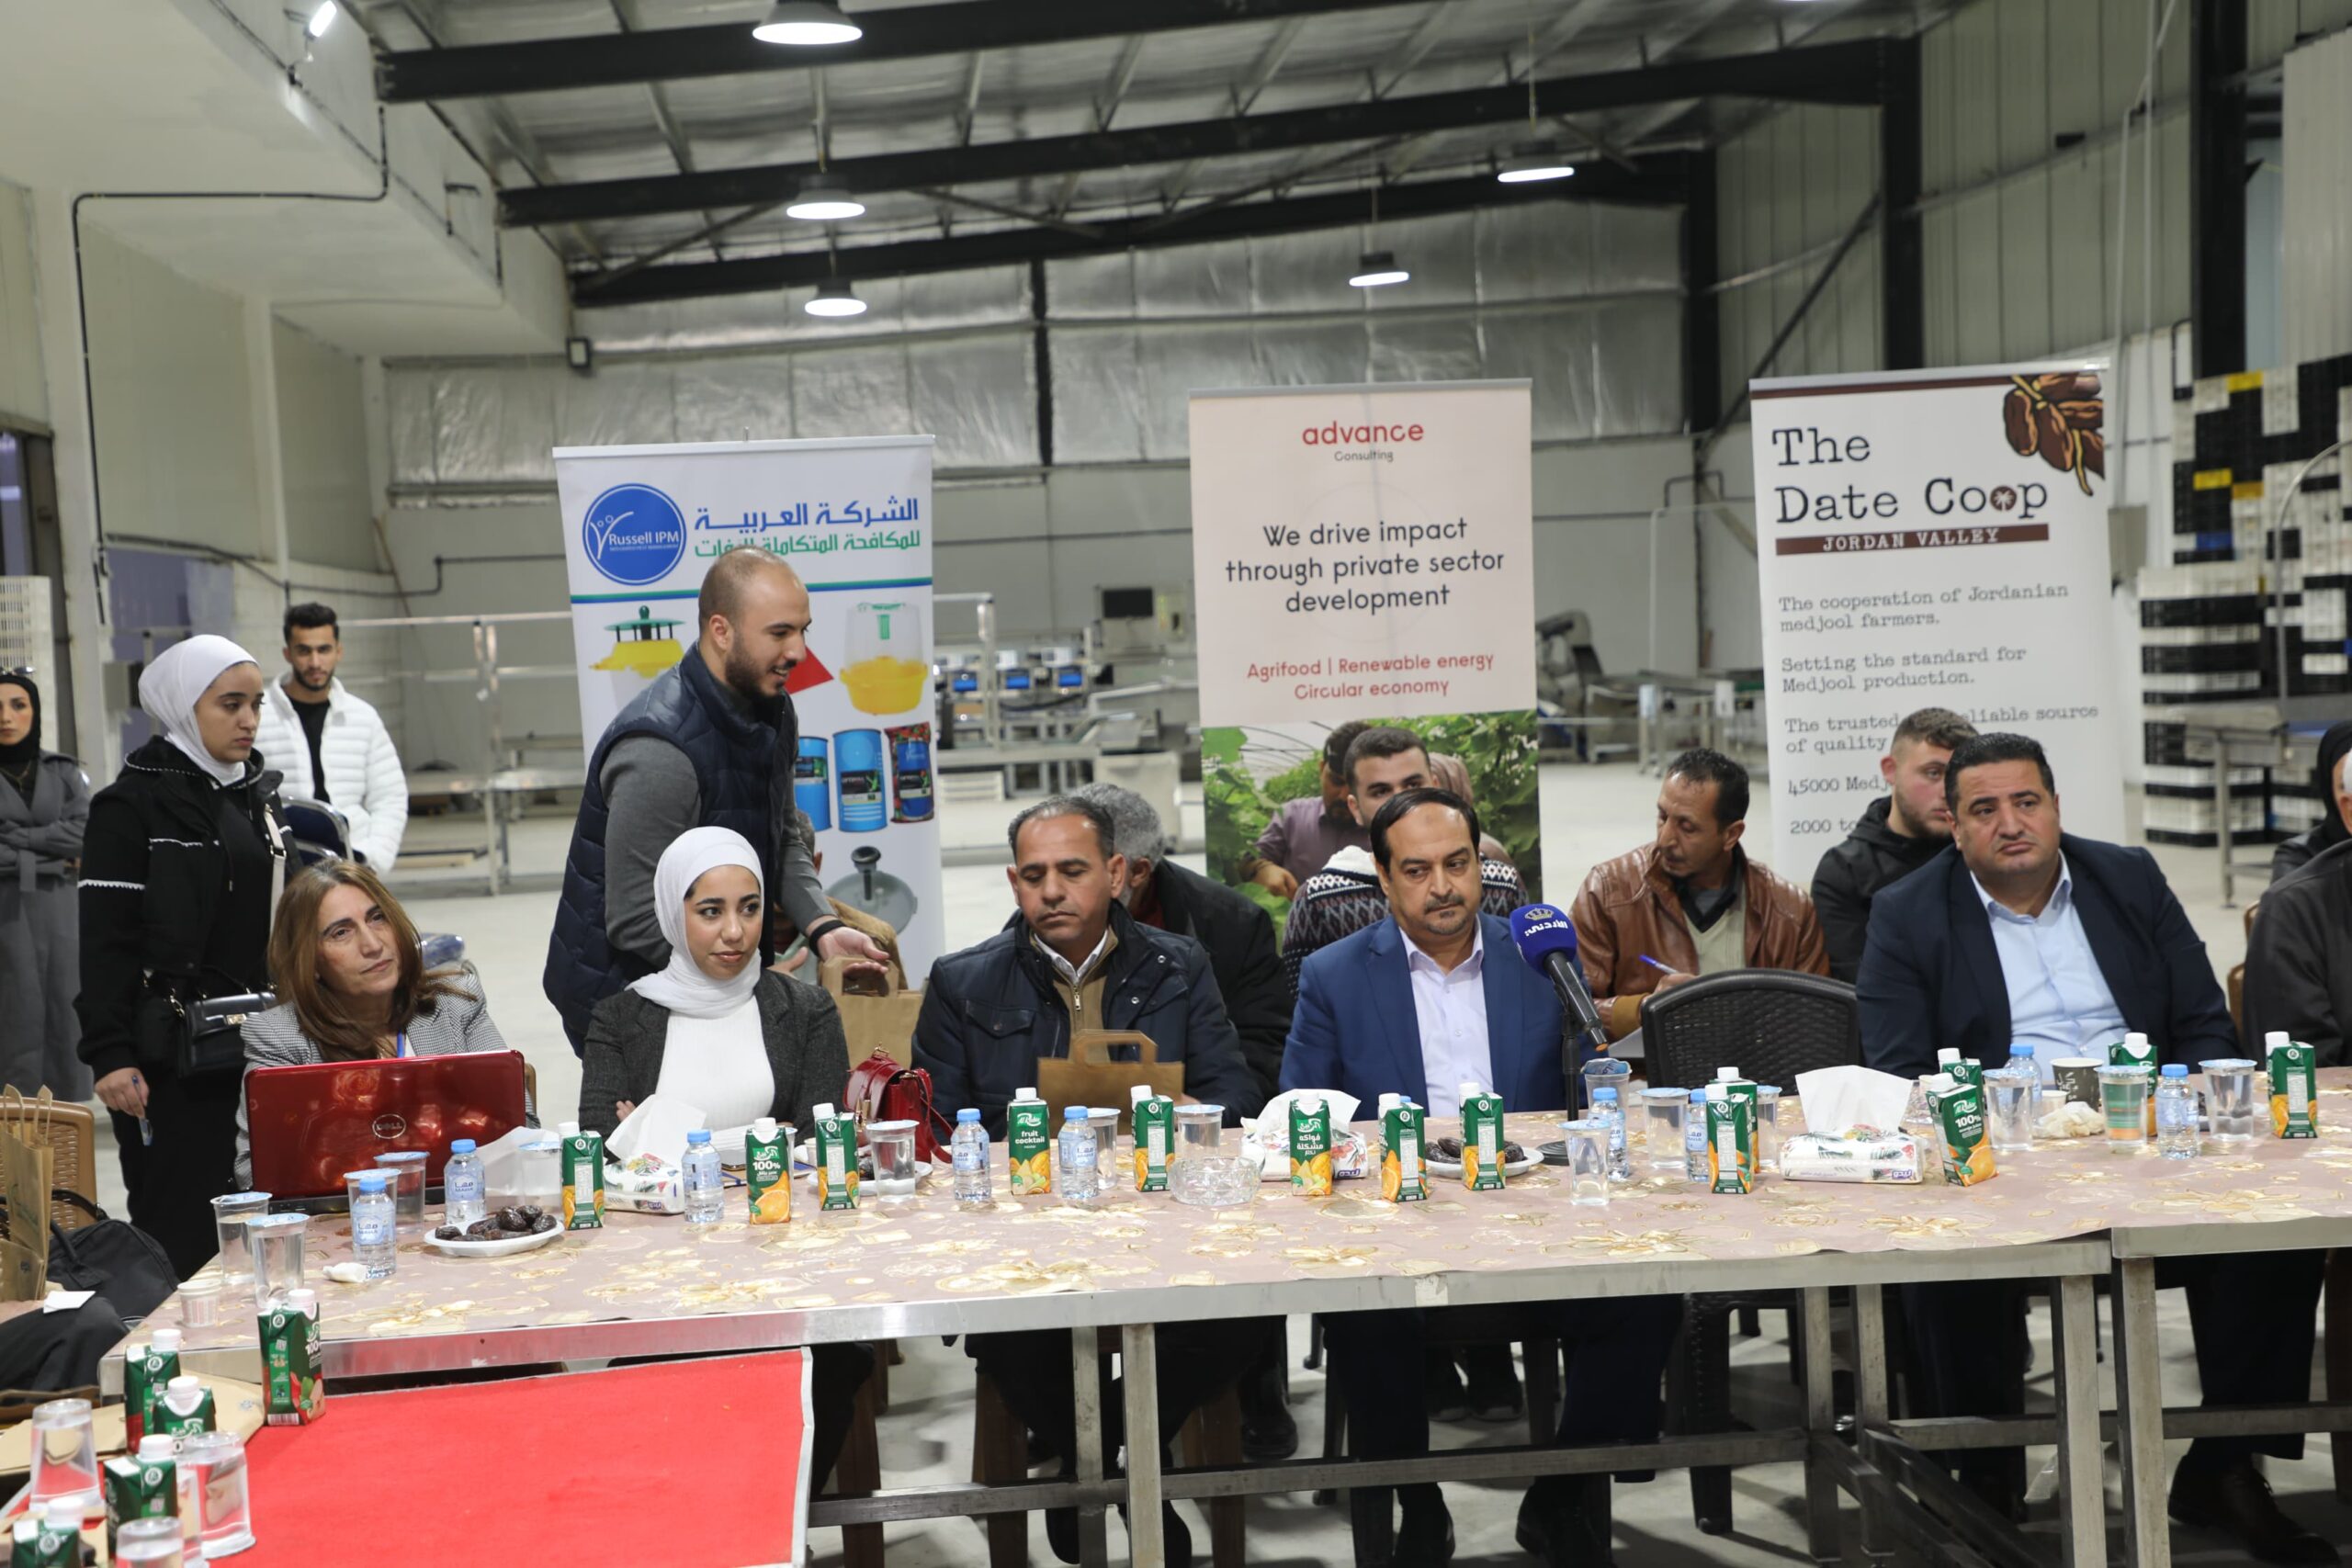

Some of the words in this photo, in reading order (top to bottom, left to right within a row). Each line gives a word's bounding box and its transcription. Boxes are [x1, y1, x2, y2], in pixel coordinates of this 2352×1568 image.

[1302, 421, 1424, 446] advance
[1334, 449, 1394, 462] Consulting
[1771, 427, 1871, 467] The
[816, 495, 919, 528] الشركة
[1774, 484, 1899, 524] Date
[695, 502, 808, 534] العربية
[608, 531, 652, 546] Russell
[655, 530, 680, 544] IPM
[843, 530, 921, 550] للمكافحة
[1262, 525, 1300, 547] We
[1309, 523, 1370, 546] drive
[1379, 517, 1467, 547] impact
[1822, 533, 1905, 552] JORDAN
[1917, 527, 2000, 547] VALLEY
[1225, 558, 1323, 586] through
[1334, 554, 1419, 584] private
[1429, 550, 1504, 573] sector
[1285, 585, 1451, 615] development
[1779, 596, 1814, 612] The
[1819, 590, 1933, 611] cooperation
[1940, 588, 1962, 603] of
[1968, 583, 2069, 603] Jordanian
[1780, 614, 1854, 633] medjool
[1860, 611, 1939, 628] farmers.
[1247, 660, 1321, 682] Agrifood
[1339, 657, 1430, 674] Renewable
[1437, 653, 1494, 671] energy
[1781, 654, 1856, 673] Setting
[1863, 652, 1894, 668] the
[1902, 649, 1989, 667] standard
[1996, 647, 2027, 661] for
[1294, 682, 1363, 700] Circular
[1369, 679, 1450, 696] economy
[1782, 673, 1856, 694] Medjool
[1863, 670, 1974, 693] production.
[1785, 717, 1820, 733] The
[1827, 713, 1899, 731] trusted
[1962, 706, 2030, 724] eliable
[2035, 705, 2099, 721] source
[1786, 738, 1807, 754] of
[1814, 735, 1887, 755] quality
[1788, 778, 1840, 796] 45000
[1790, 818, 1832, 835] 2000
[1955, 1113, 1982, 1128] 100%
[752, 1161, 780, 1170] 100%
